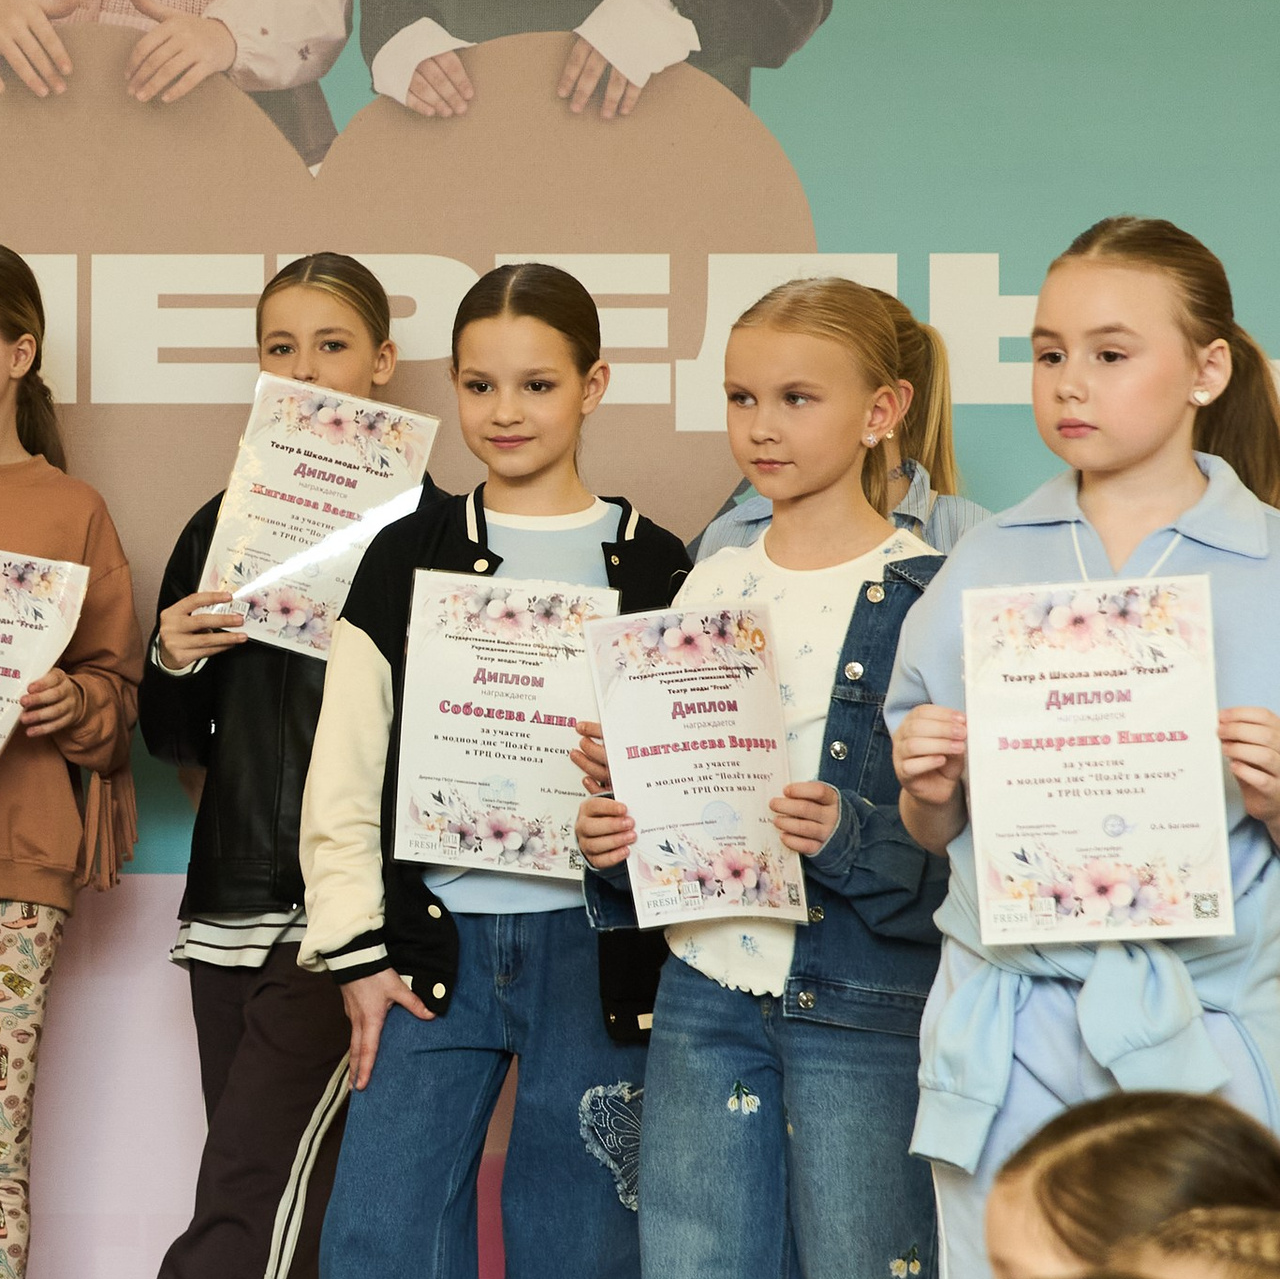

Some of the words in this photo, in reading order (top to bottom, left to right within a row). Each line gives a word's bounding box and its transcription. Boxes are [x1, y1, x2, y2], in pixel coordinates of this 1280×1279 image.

[293, 461, 358, 489] Диплом
[472, 666, 545, 688] Диплом
[1045, 689, 1132, 711] Диплом
[439, 699, 526, 722] Соболева
[530, 710, 577, 728] Анна
[671, 699, 738, 720] Диплом
[442, 735, 478, 744] модном
[500, 741, 533, 751] "Полёт
[493, 729, 531, 739] участие
[474, 749, 492, 758] ТРЦ
[494, 752, 517, 761] Охта
[520, 756, 543, 764] молл
[409, 840, 437, 850] FRESH
[647, 897, 678, 909] FRESH
